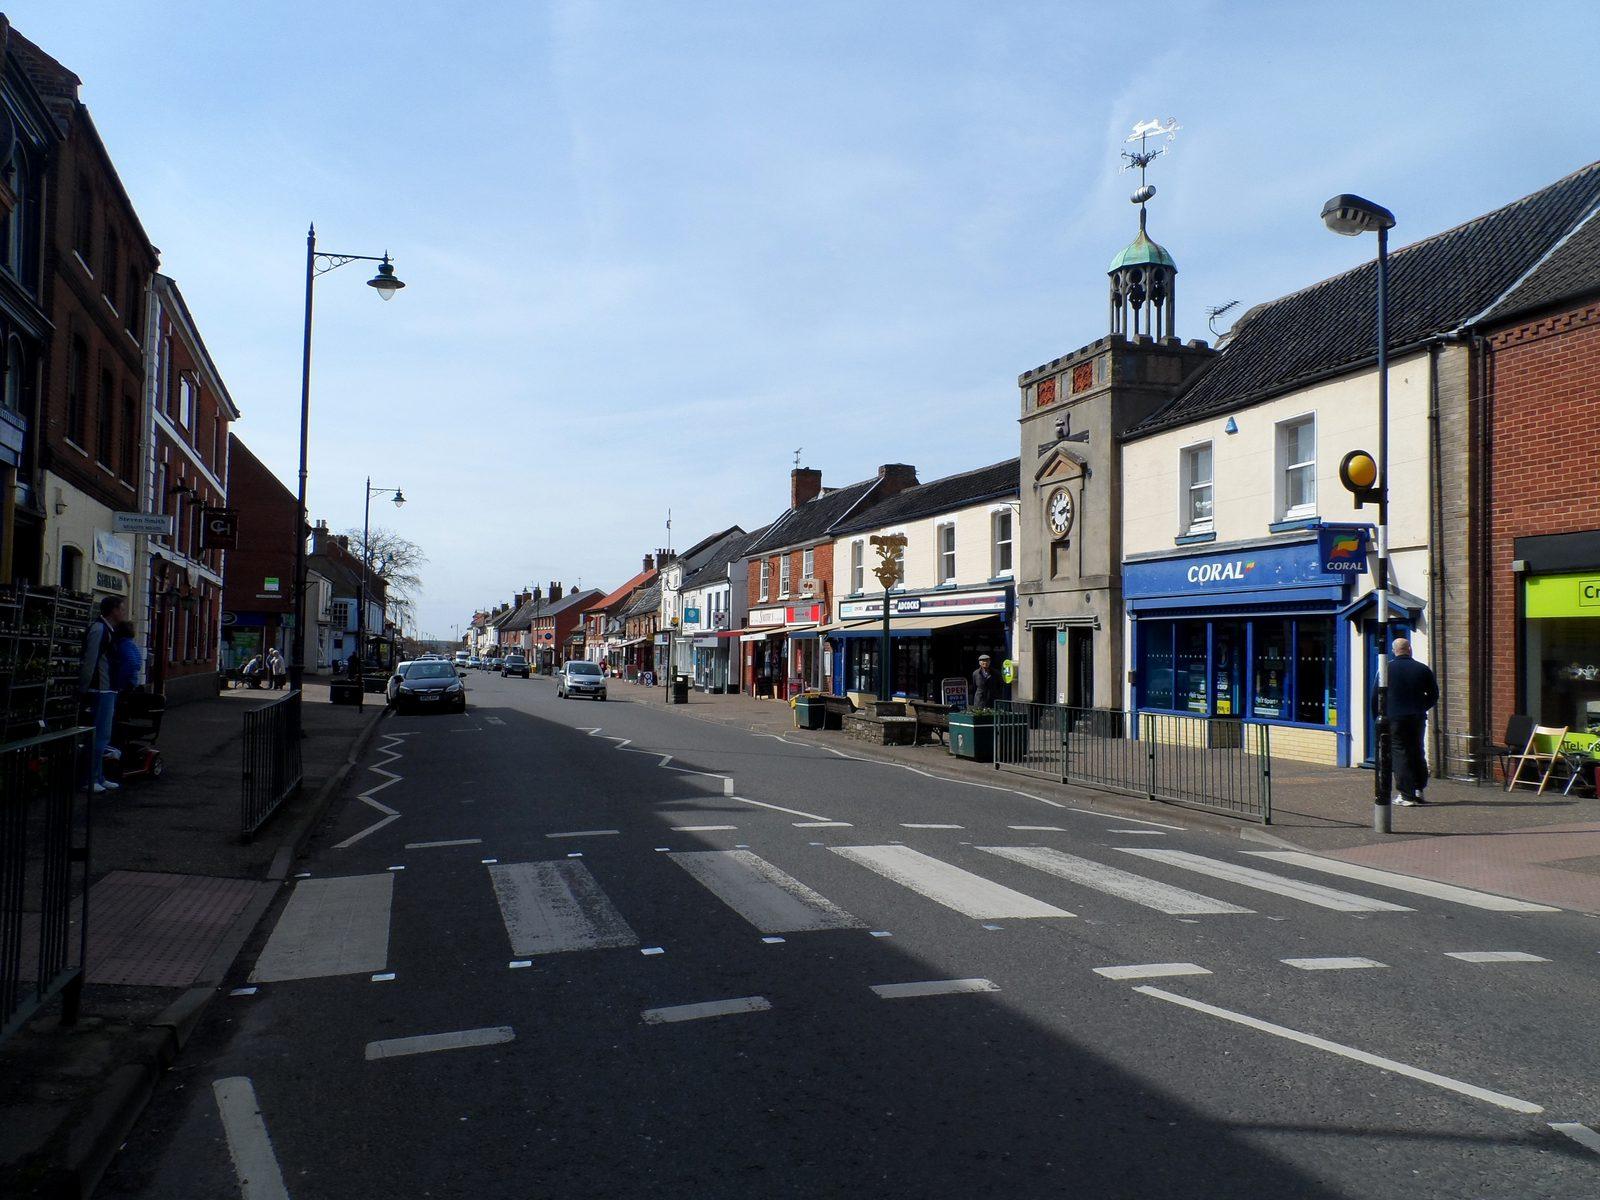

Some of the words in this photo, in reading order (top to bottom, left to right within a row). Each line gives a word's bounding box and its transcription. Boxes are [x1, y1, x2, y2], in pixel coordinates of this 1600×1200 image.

[1187, 560, 1244, 583] CORAL
[1326, 561, 1363, 571] CORAL
[897, 600, 920, 611] ADCOCKS
[1563, 740, 1583, 751] Tel:
